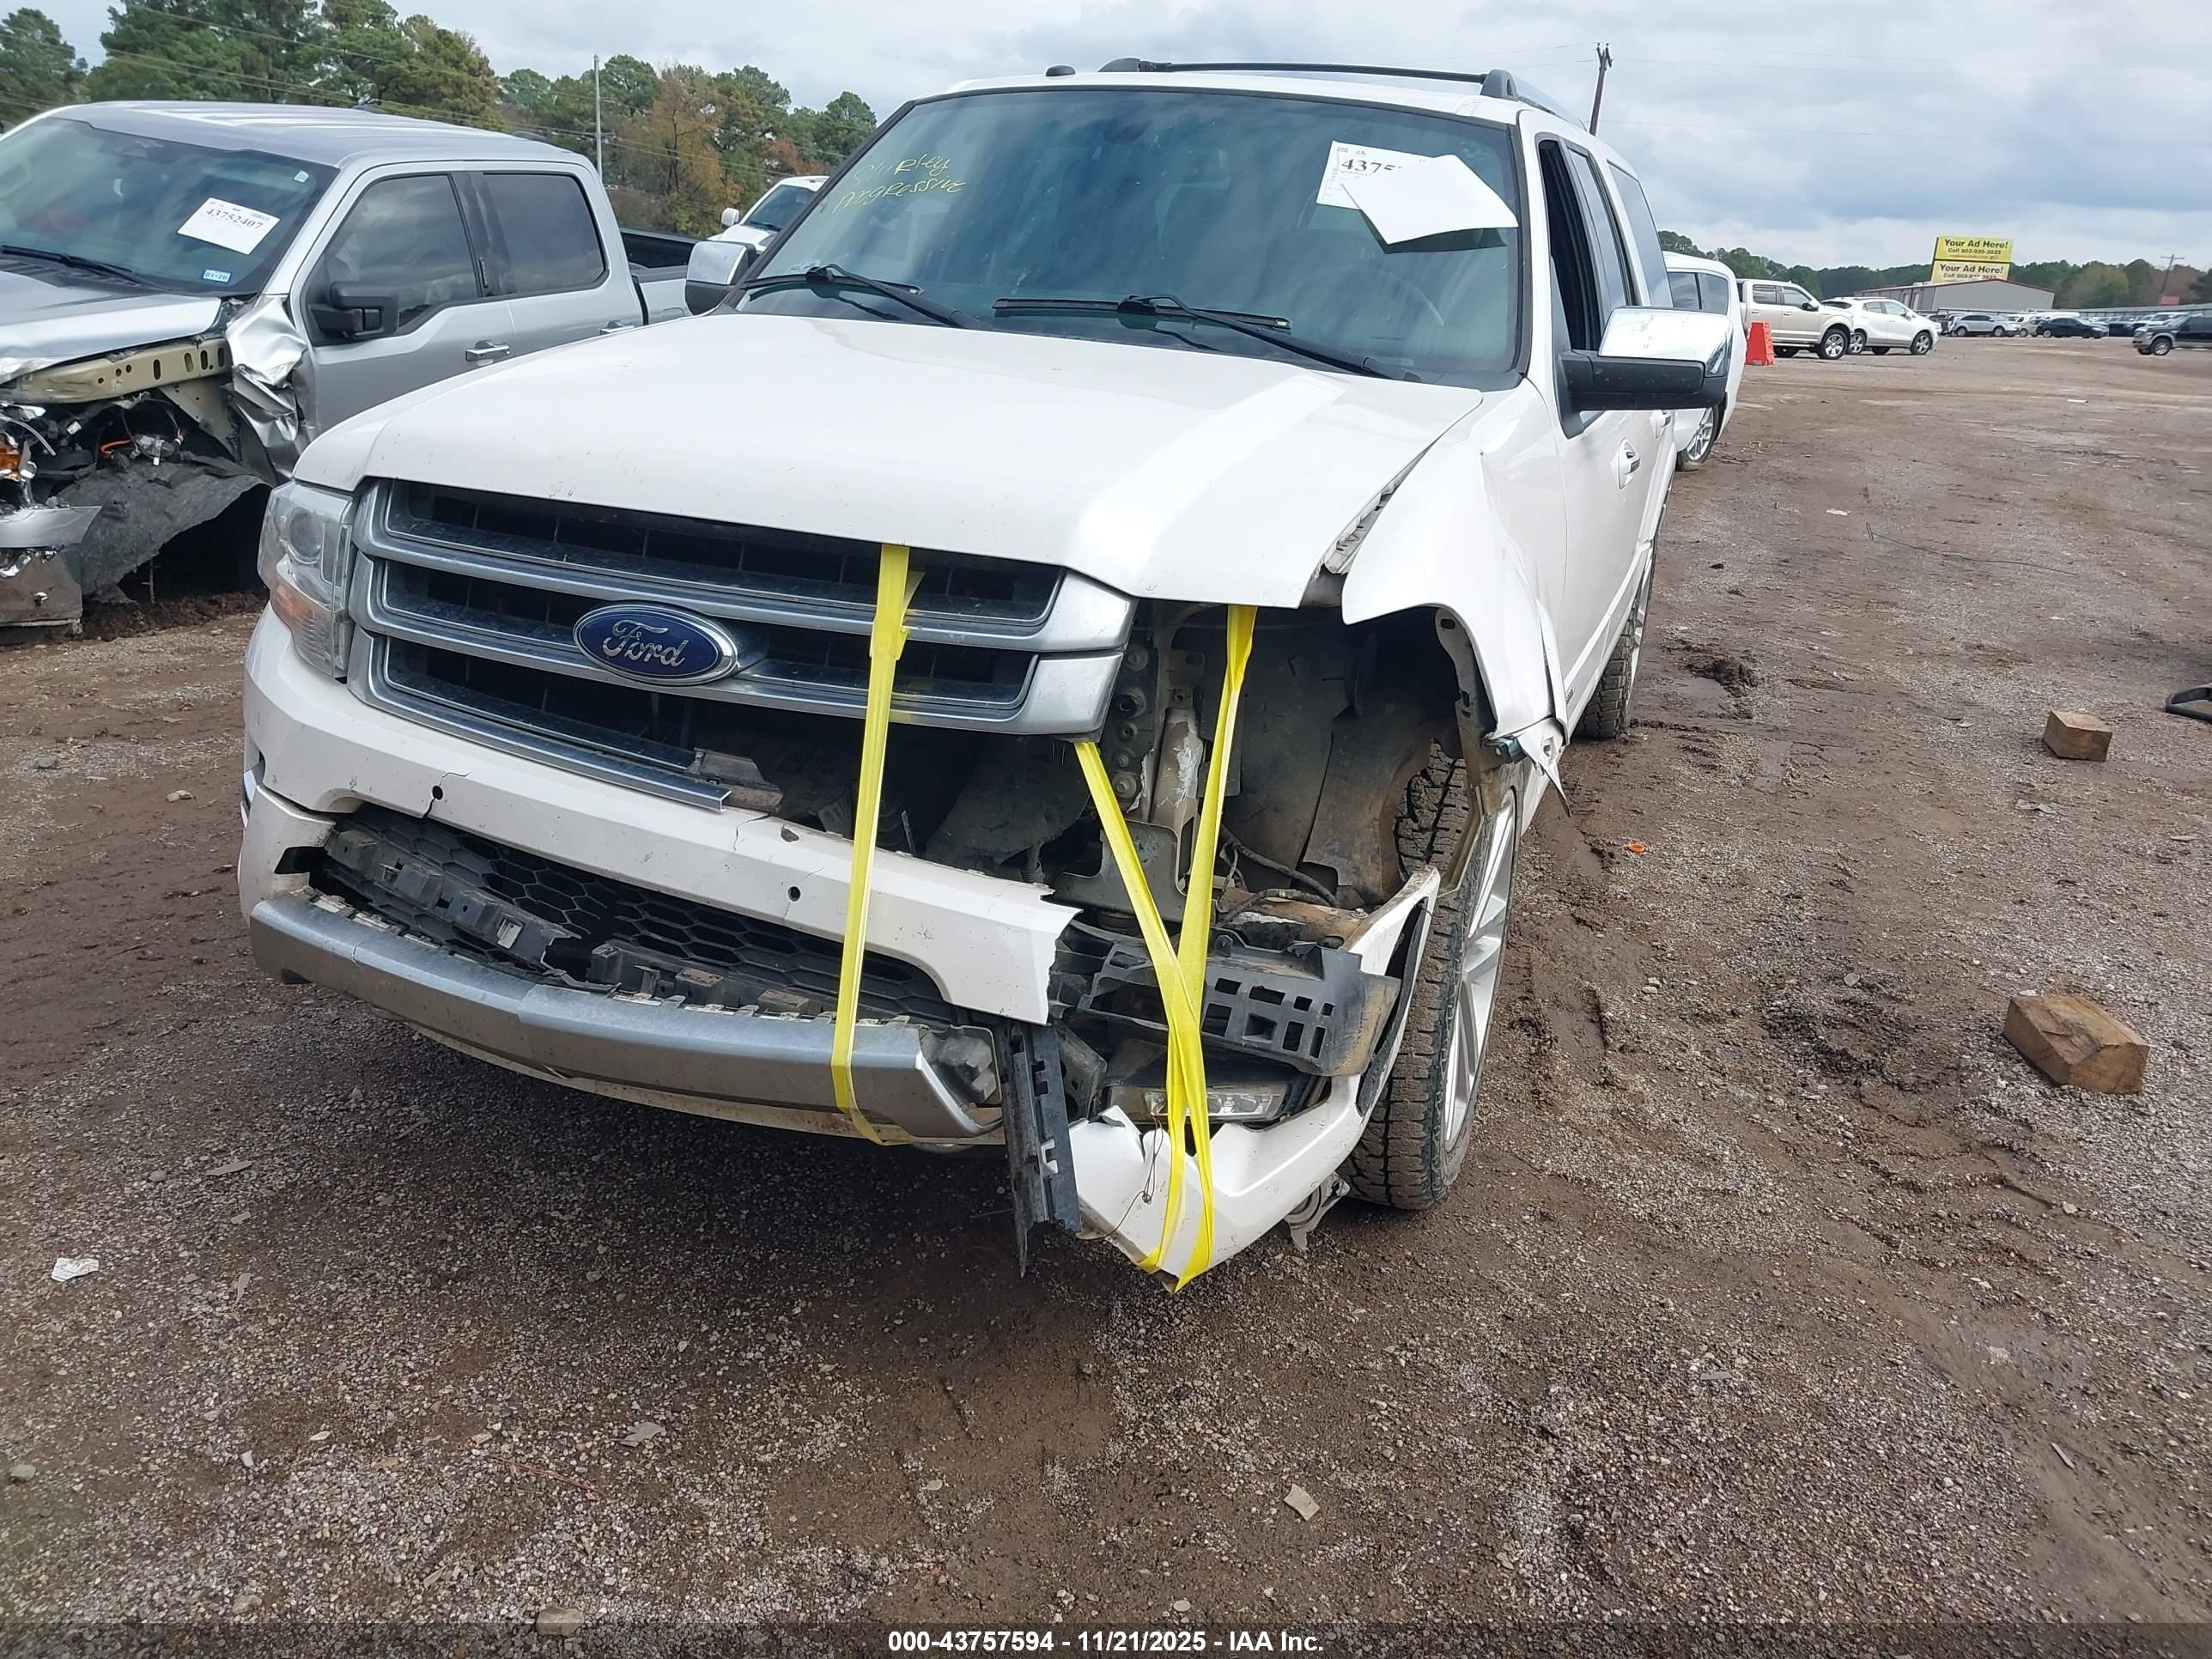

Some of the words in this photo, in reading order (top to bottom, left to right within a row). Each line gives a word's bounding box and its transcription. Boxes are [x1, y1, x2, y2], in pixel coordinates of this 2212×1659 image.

[1341, 157, 1403, 173] 4375
[205, 208, 264, 229] 43752407
[1944, 239, 1965, 247] Your
[1940, 264, 1960, 272] Your
[1962, 264, 1975, 273] Ad
[1978, 265, 2004, 274] Here!
[602, 619, 690, 667] Ford
